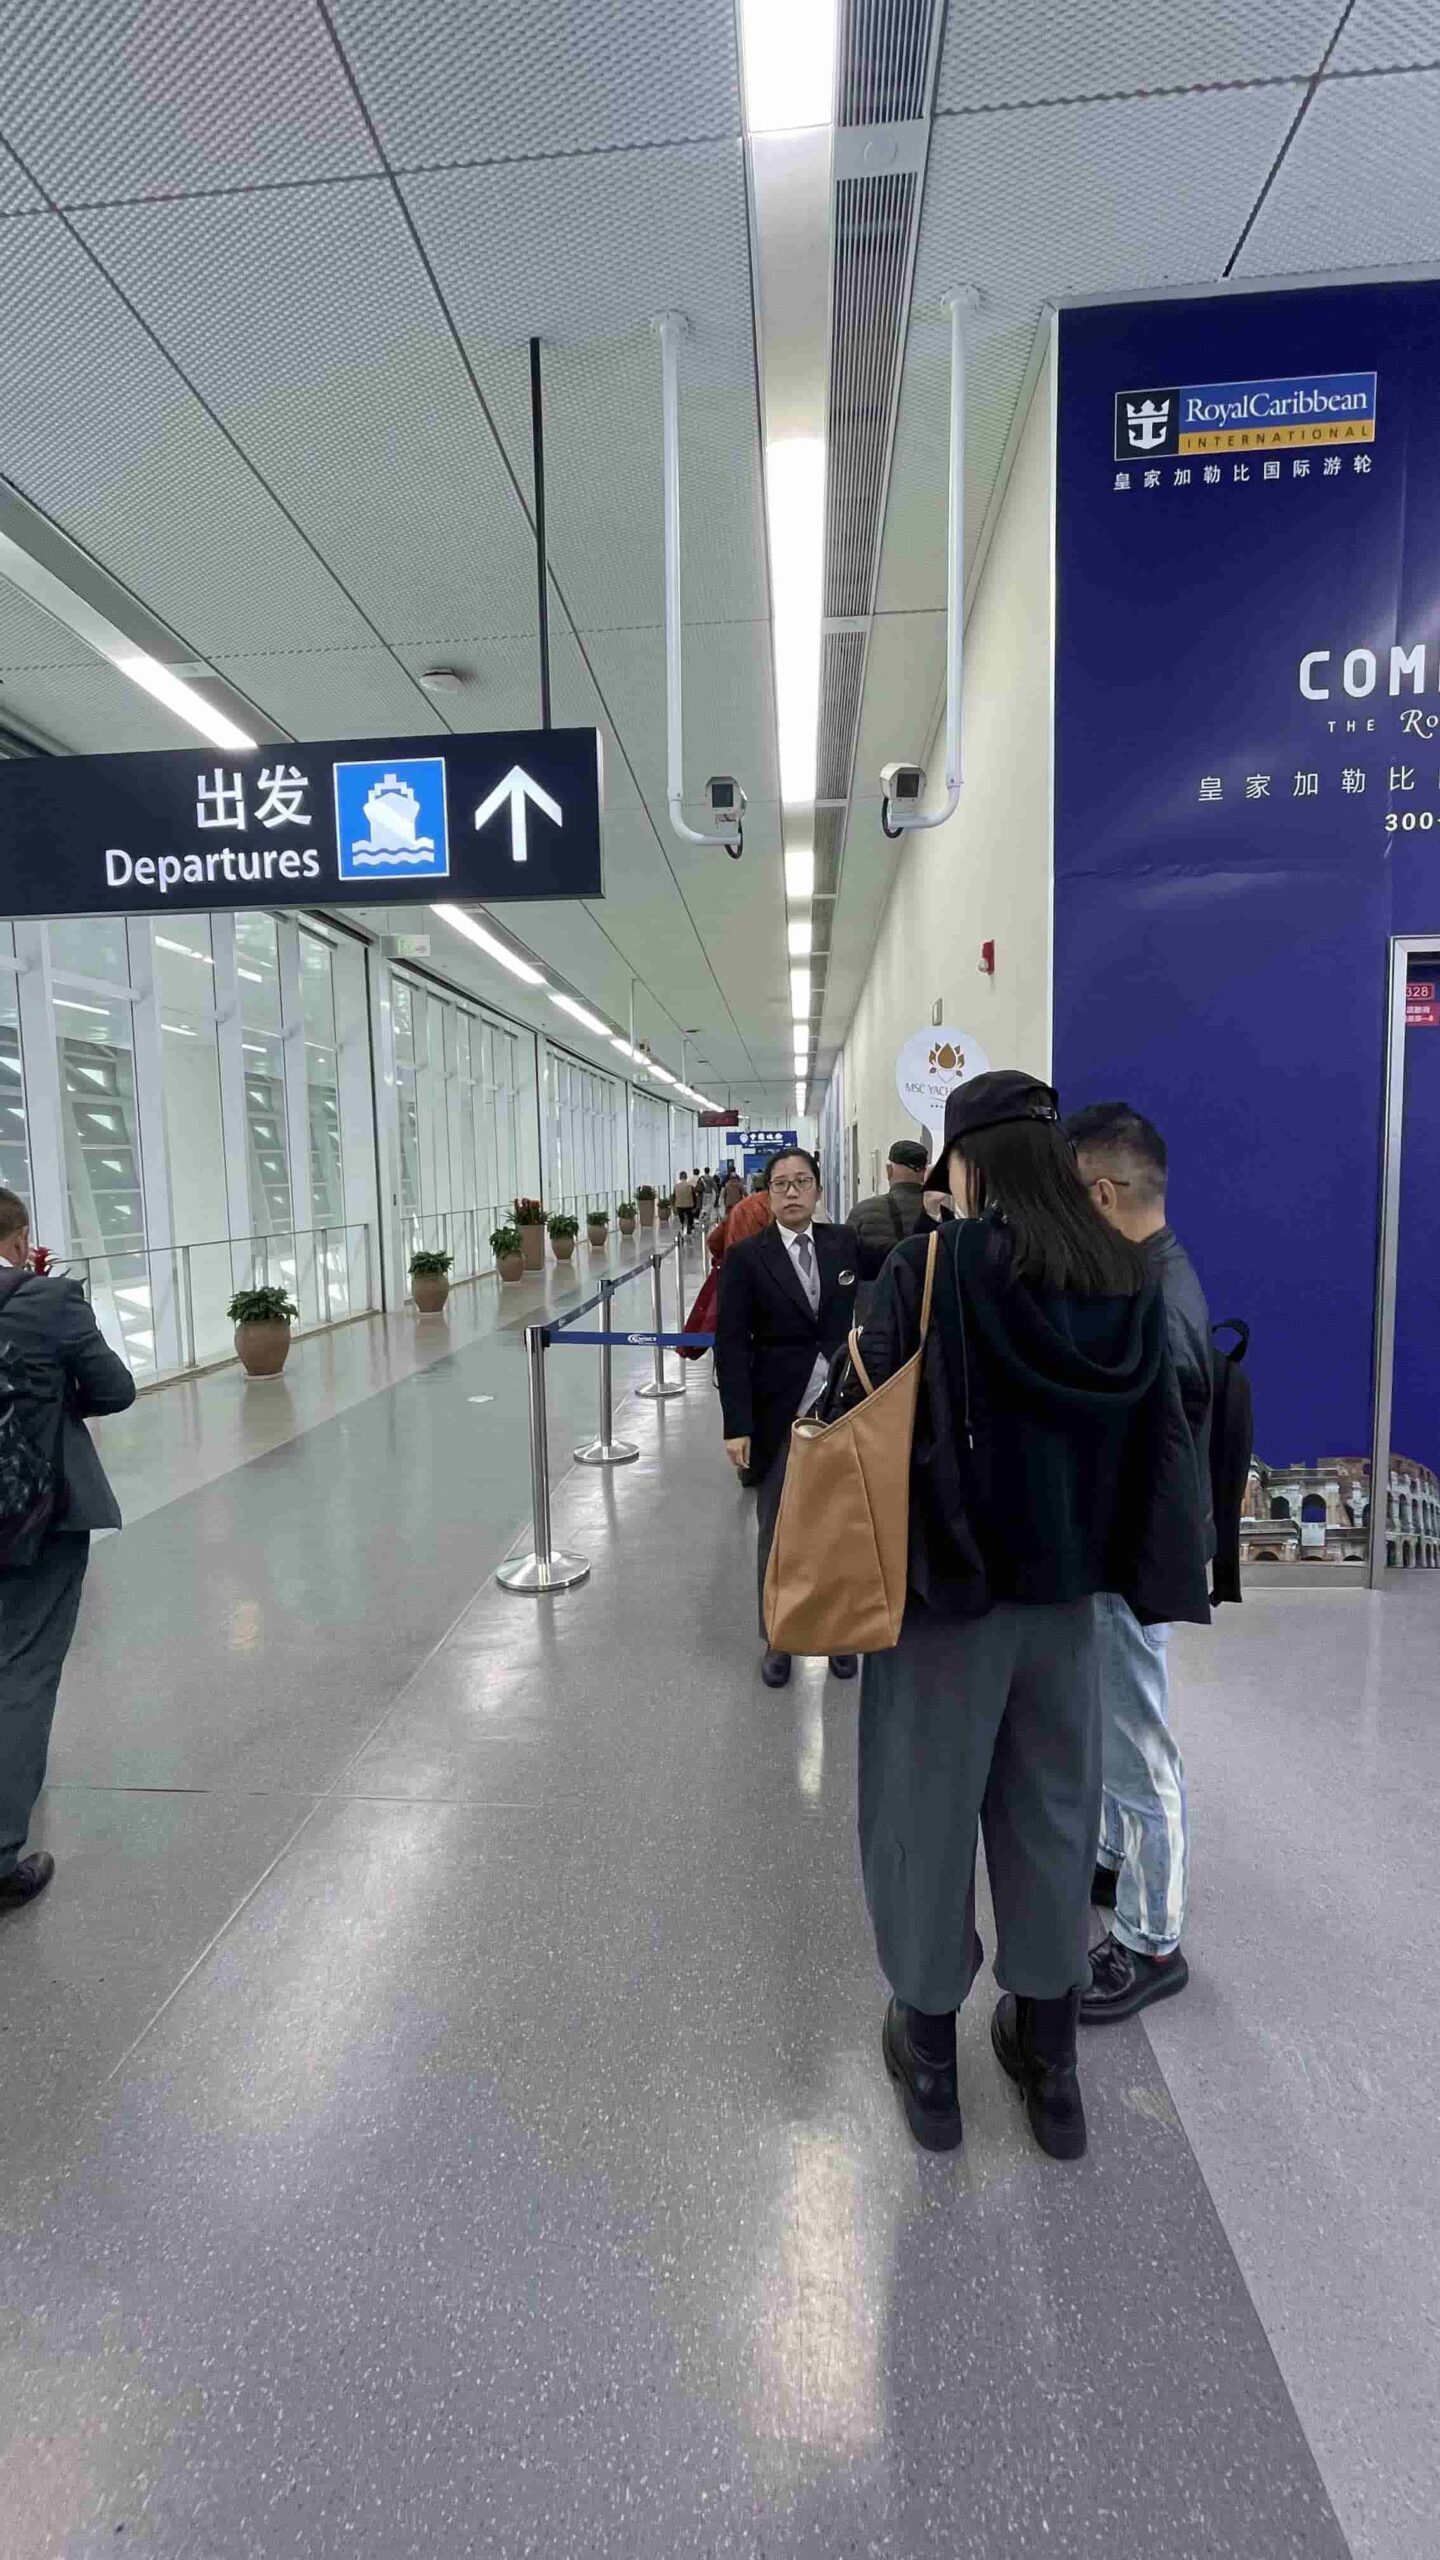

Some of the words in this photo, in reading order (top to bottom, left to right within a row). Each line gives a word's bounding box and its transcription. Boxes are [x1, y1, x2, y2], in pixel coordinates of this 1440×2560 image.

[1187, 425, 1369, 449] INTERNATIONAL
[1299, 644, 1440, 700] COM
[1328, 719, 1375, 733] THE
[196, 764, 312, 831] 出发
[1198, 765, 1440, 801] 皇家加勒比
[1384, 811, 1440, 832] 300
[105, 844, 321, 893] Departures
[905, 1083, 925, 1094] MSC
